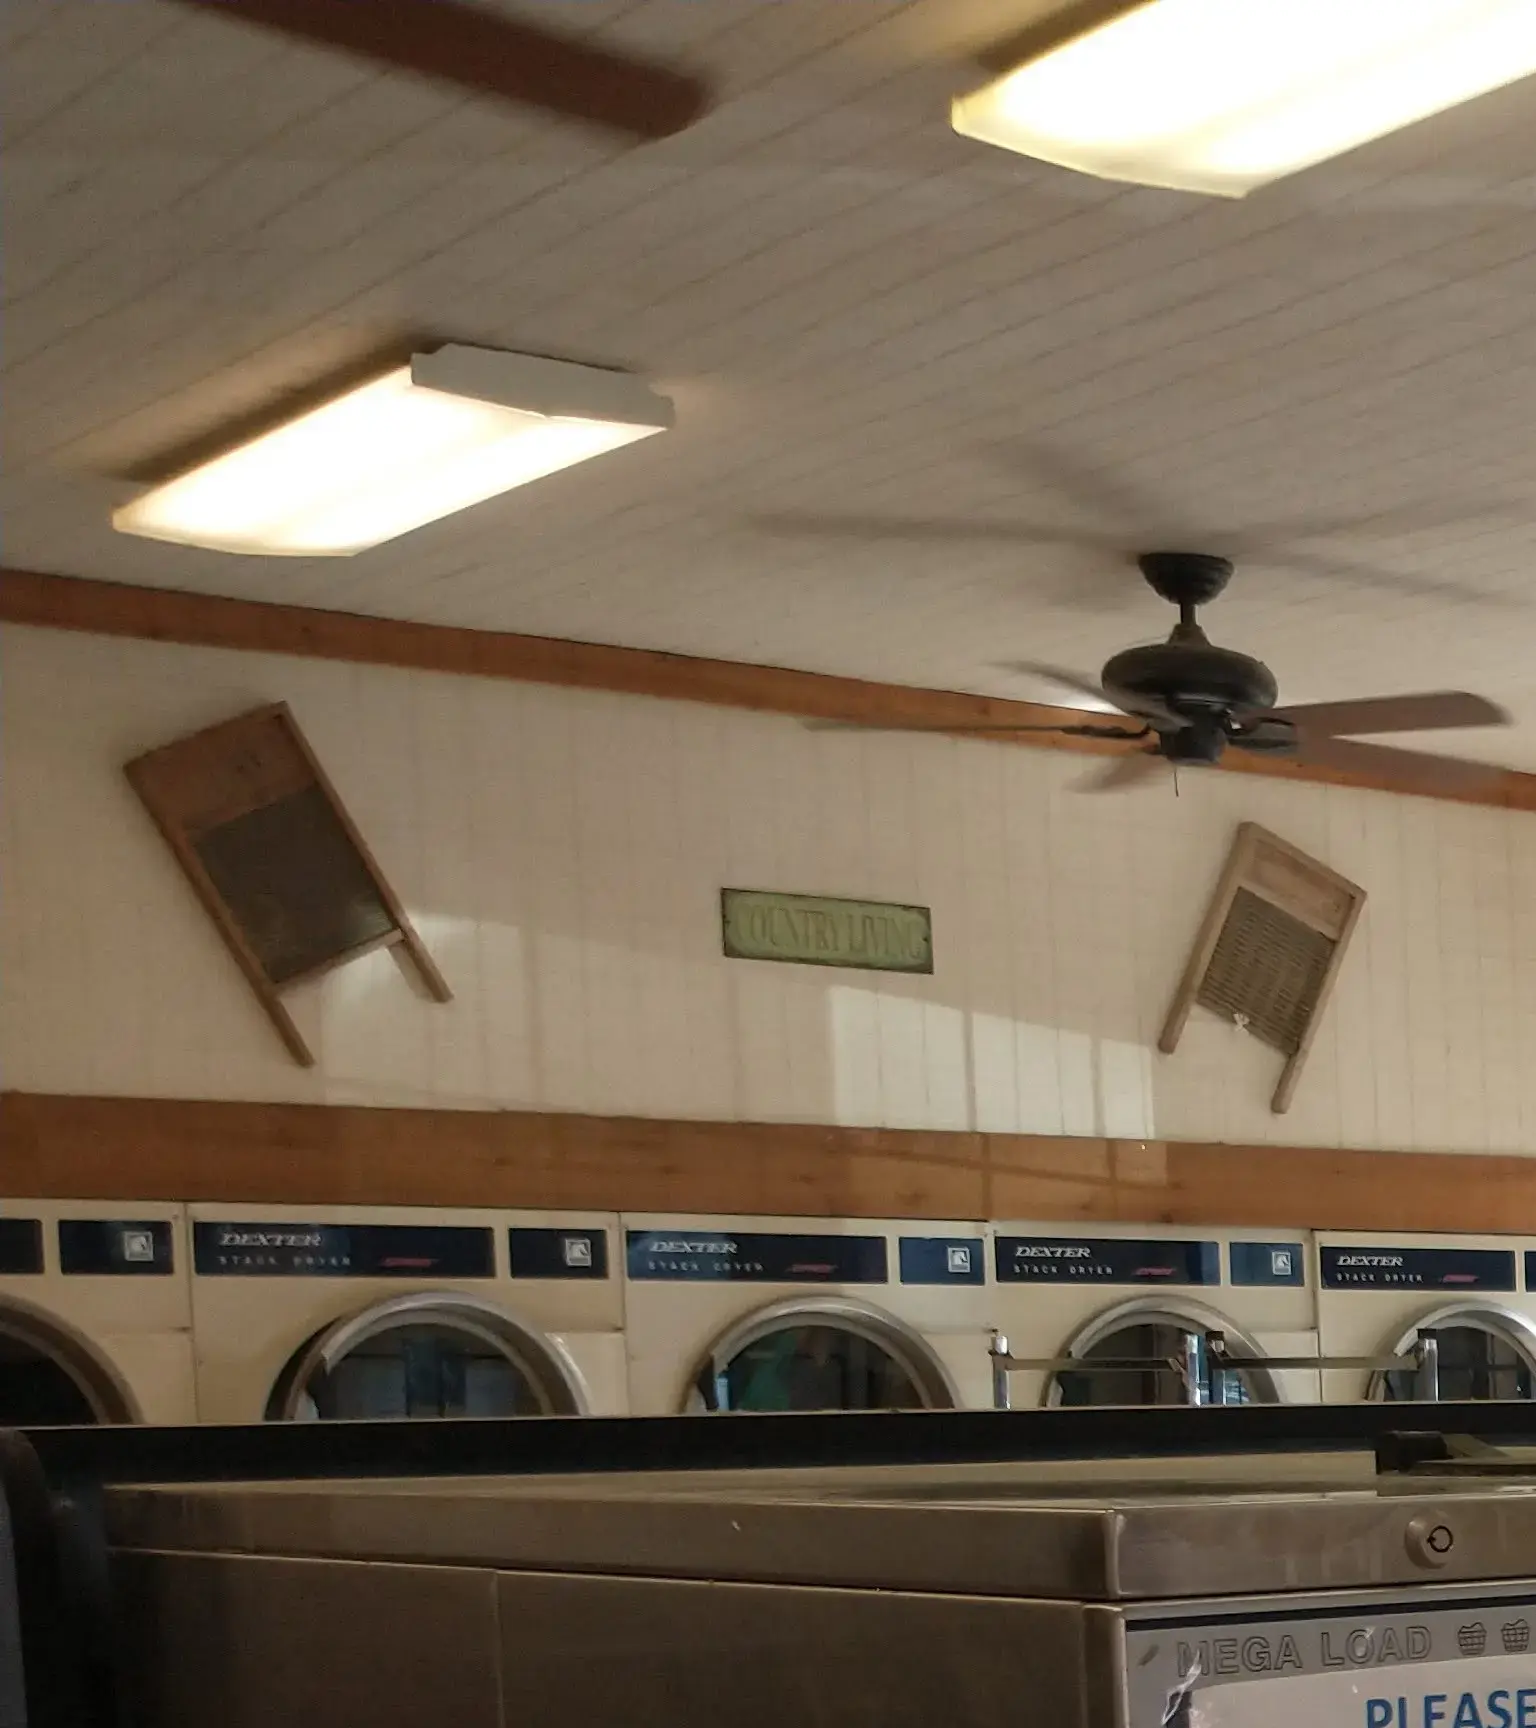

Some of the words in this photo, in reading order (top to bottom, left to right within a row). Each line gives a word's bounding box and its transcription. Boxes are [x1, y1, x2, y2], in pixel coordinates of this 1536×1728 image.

[1014, 1246, 1092, 1258] DEXTER
[1336, 1255, 1404, 1266] DEXTER
[1176, 1634, 1303, 1678] MEGA
[1320, 1626, 1432, 1667] LOAD
